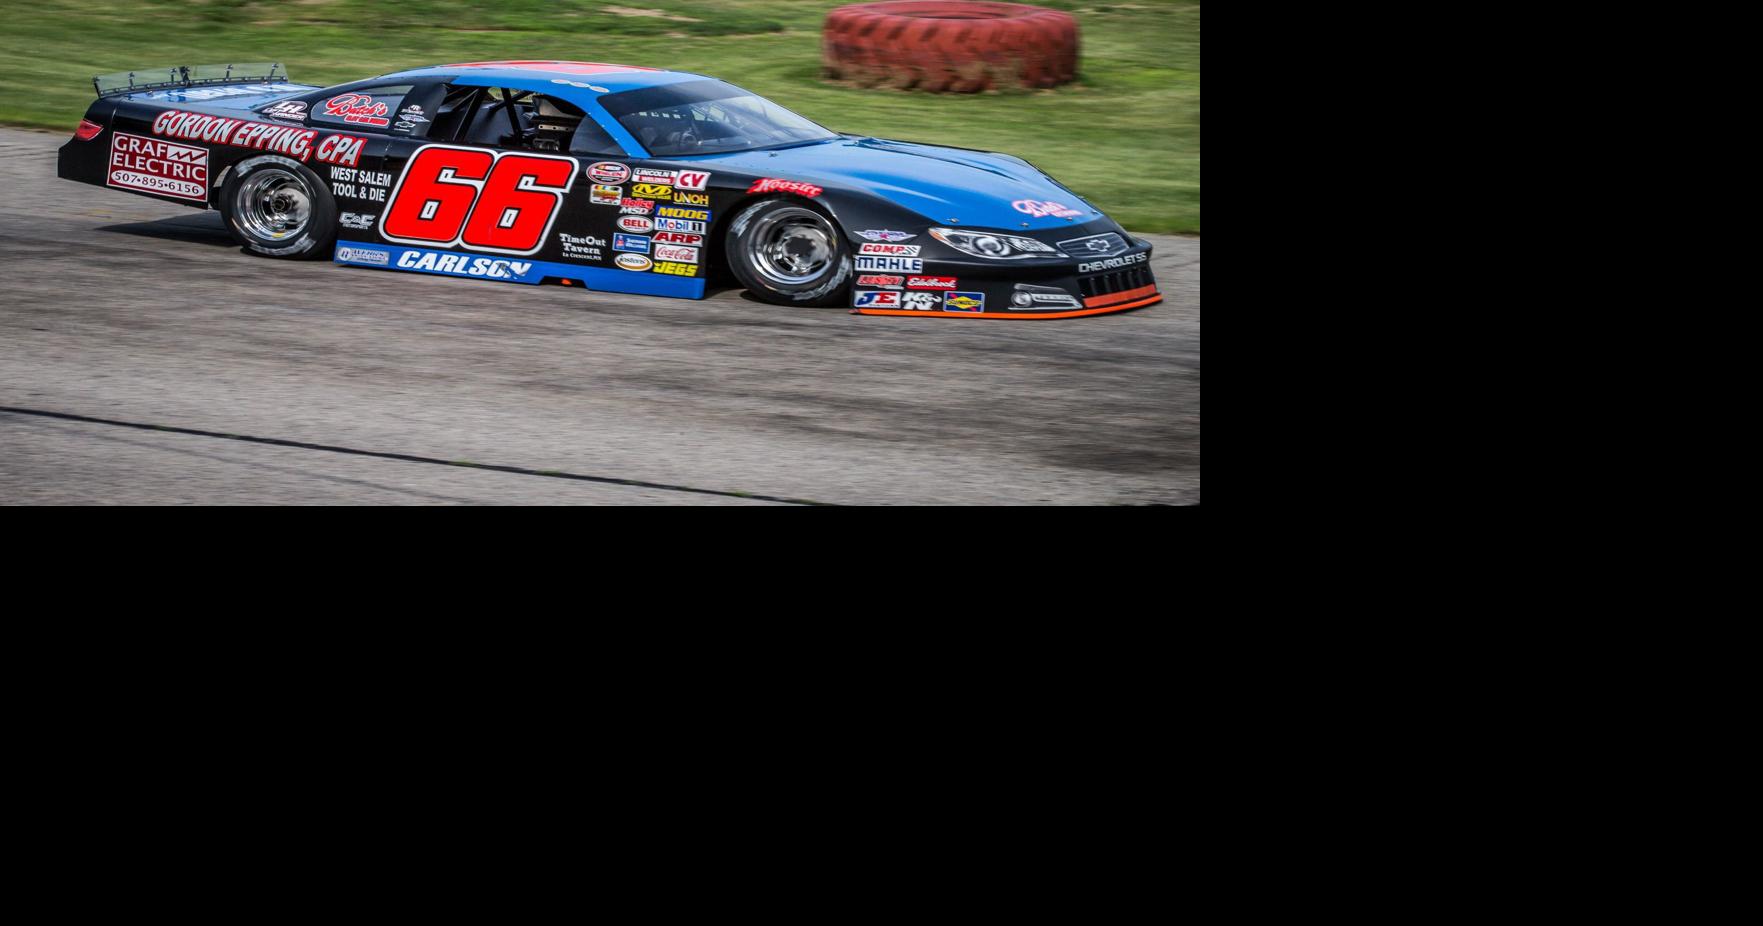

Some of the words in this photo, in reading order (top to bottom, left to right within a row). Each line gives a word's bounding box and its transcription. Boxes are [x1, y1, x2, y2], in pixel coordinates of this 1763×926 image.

[152, 110, 239, 143] GORDON
[231, 121, 316, 161] EPPING,
[316, 134, 366, 167] CPA
[114, 136, 168, 157] GRAF
[112, 152, 206, 181] ELECTRIC
[636, 169, 671, 177] LINCOLN
[330, 166, 358, 181] WEST
[358, 170, 392, 187] SALEM
[679, 173, 705, 187] CV
[332, 182, 357, 198] TOOL
[359, 186, 367, 199] &
[369, 187, 386, 202] DIE
[748, 178, 822, 197] Hoosier
[380, 144, 579, 256] 66
[673, 191, 709, 205] UNOH
[619, 207, 649, 215] MSD
[658, 207, 708, 220] MOOG
[623, 218, 649, 228] BELL
[657, 218, 689, 231] Mobil
[653, 232, 701, 244] ARP
[563, 243, 601, 255] Tavern
[863, 244, 904, 253] COMP
[396, 250, 533, 280] CARLSON
[653, 262, 698, 277] JEGS
[857, 256, 921, 271] MAHLE
[1078, 255, 1136, 273] CHEVROLET
[856, 292, 897, 306] JE
